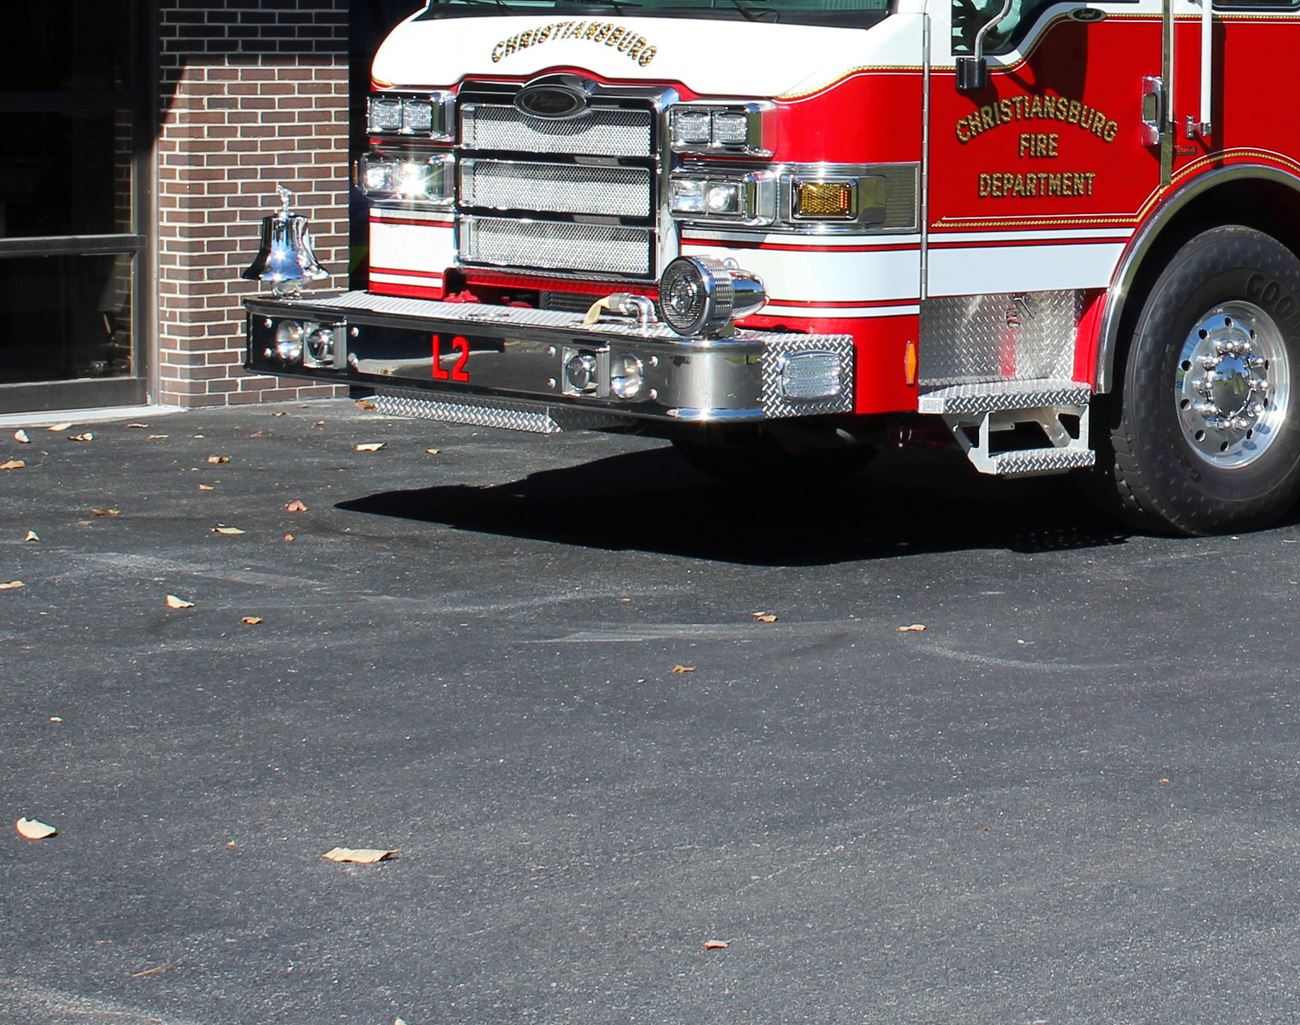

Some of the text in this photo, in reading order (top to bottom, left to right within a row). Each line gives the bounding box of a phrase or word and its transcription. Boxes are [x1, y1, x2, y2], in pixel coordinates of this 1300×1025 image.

[491, 20, 657, 67] CHRISTIANSBURG
[956, 95, 1118, 144] CHRISTIANSBURG
[1018, 133, 1059, 158] FIRE
[978, 172, 1096, 198] DEPARTMENT
[431, 333, 470, 383] L2
